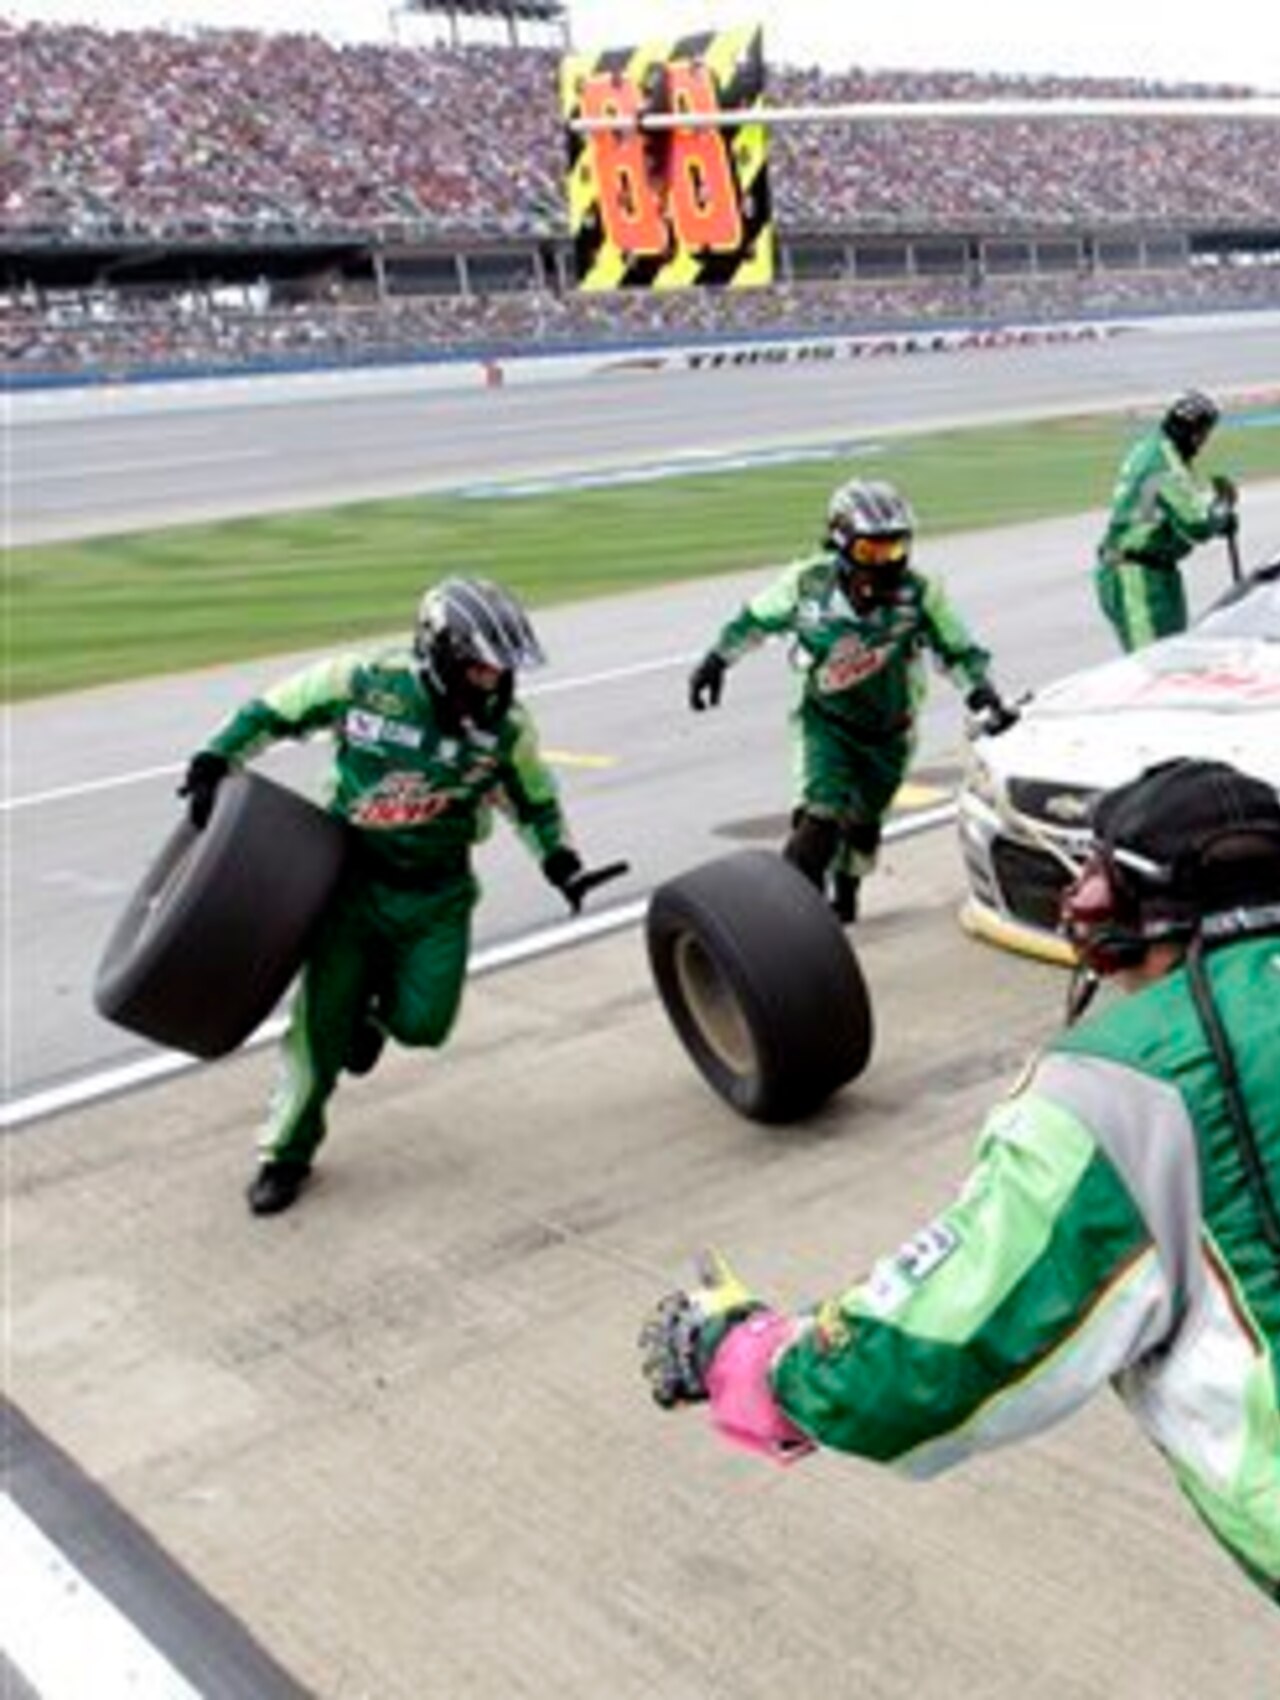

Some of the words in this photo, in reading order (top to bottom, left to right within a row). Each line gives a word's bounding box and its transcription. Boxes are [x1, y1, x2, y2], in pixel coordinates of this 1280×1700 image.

[579, 61, 742, 256] 88
[685, 349, 786, 368] THIS
[796, 347, 834, 362] IS
[848, 327, 1097, 357] TALLADEGA
